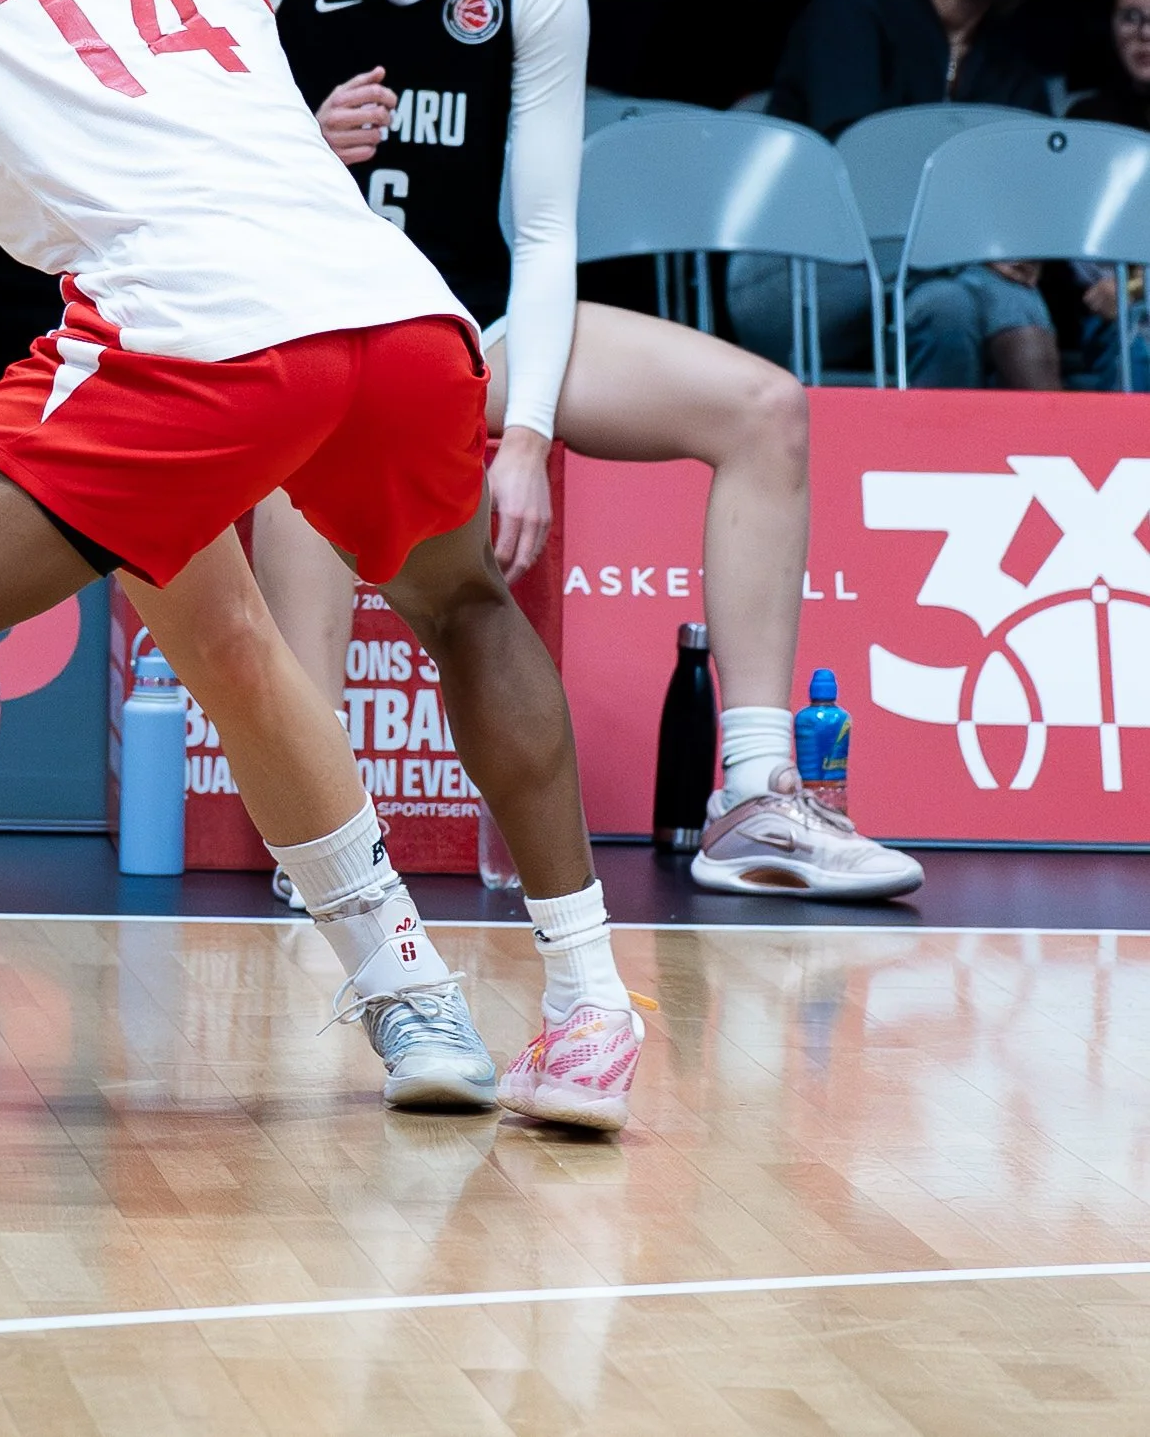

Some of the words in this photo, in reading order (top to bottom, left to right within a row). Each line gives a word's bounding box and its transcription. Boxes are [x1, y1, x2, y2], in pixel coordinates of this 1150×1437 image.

[379, 89, 467, 147] MRU
[346, 640, 412, 681] ONS
[402, 759, 482, 798] EVEN
